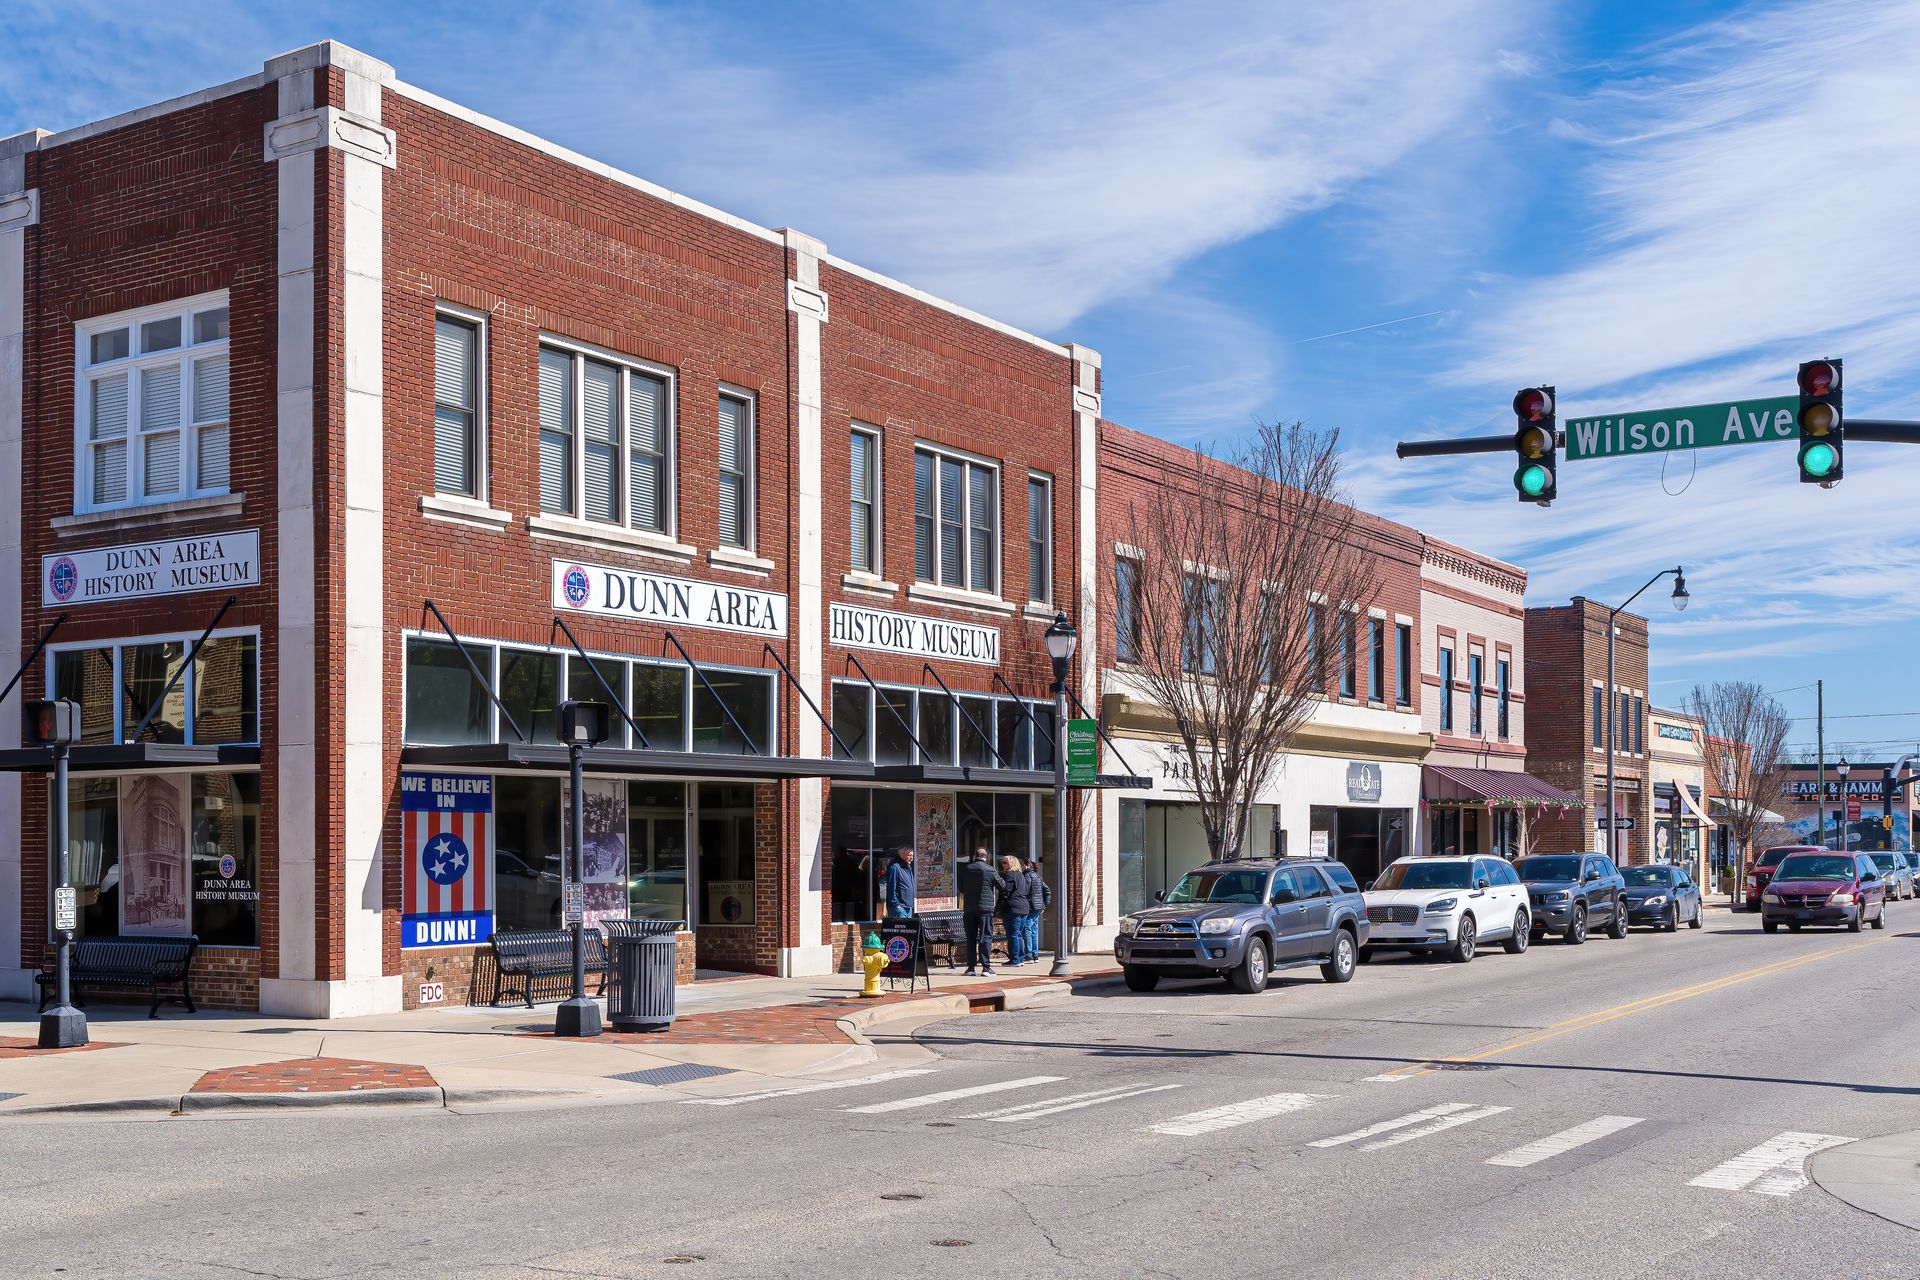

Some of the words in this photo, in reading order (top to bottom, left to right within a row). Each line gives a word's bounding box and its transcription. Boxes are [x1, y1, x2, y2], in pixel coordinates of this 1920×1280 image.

[1575, 418, 1695, 456] Wilson
[1722, 406, 1793, 442] Ave
[106, 546, 162, 571] DUNN
[172, 540, 225, 564] AREA
[84, 571, 159, 596] HISTORY
[170, 561, 250, 588] MUSEUM
[603, 572, 692, 619] DUNN
[706, 588, 778, 631] AREA
[831, 607, 917, 650] HISTORY
[921, 622, 997, 661] MUSEUM
[401, 776, 426, 792] WE
[431, 777, 490, 794] BELIEVE
[1829, 782, 1838, 793] &
[437, 794, 456, 808] IN
[203, 880, 228, 889] DUNN
[229, 880, 251, 889] AREA
[195, 891, 227, 900] HISTORY
[227, 891, 260, 900] MUSEUM
[416, 919, 477, 944] DUNN!
[420, 984, 443, 1001] FDC
